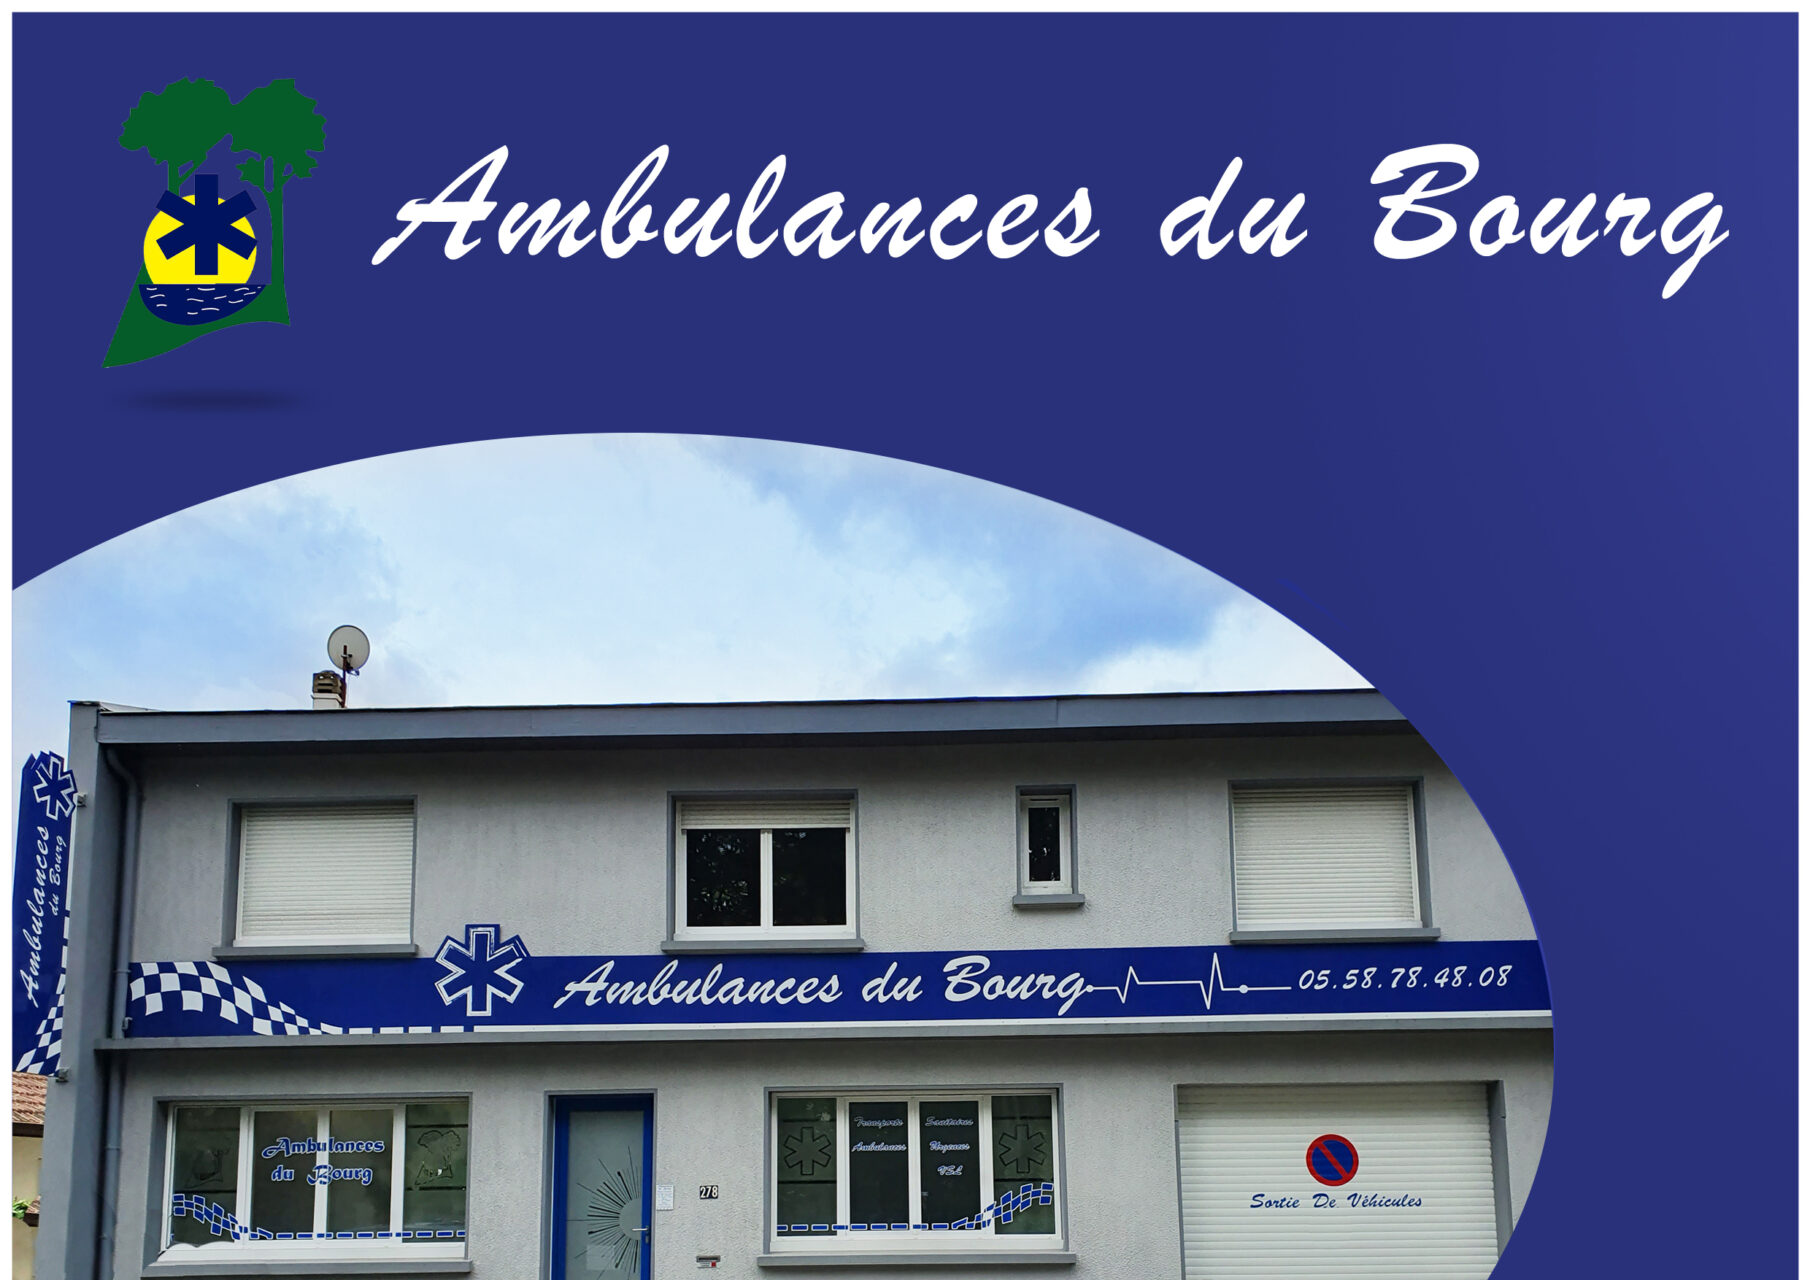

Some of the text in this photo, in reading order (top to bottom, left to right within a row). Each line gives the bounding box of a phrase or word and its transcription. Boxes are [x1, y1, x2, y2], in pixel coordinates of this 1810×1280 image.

[371, 143, 1730, 300] Ambulances du Bourg
[48, 835, 67, 916] du Bourg
[20, 826, 49, 1009] Ambulances
[553, 954, 1086, 1017] Ambulances du Bourg
[1298, 965, 1513, 990] 05.58.78.48.08
[261, 1136, 386, 1159] Ambulances
[271, 1164, 374, 1186] du Bourg
[700, 1185, 719, 1199] 278
[1250, 1192, 1423, 1209] Sortie De Véhicules
